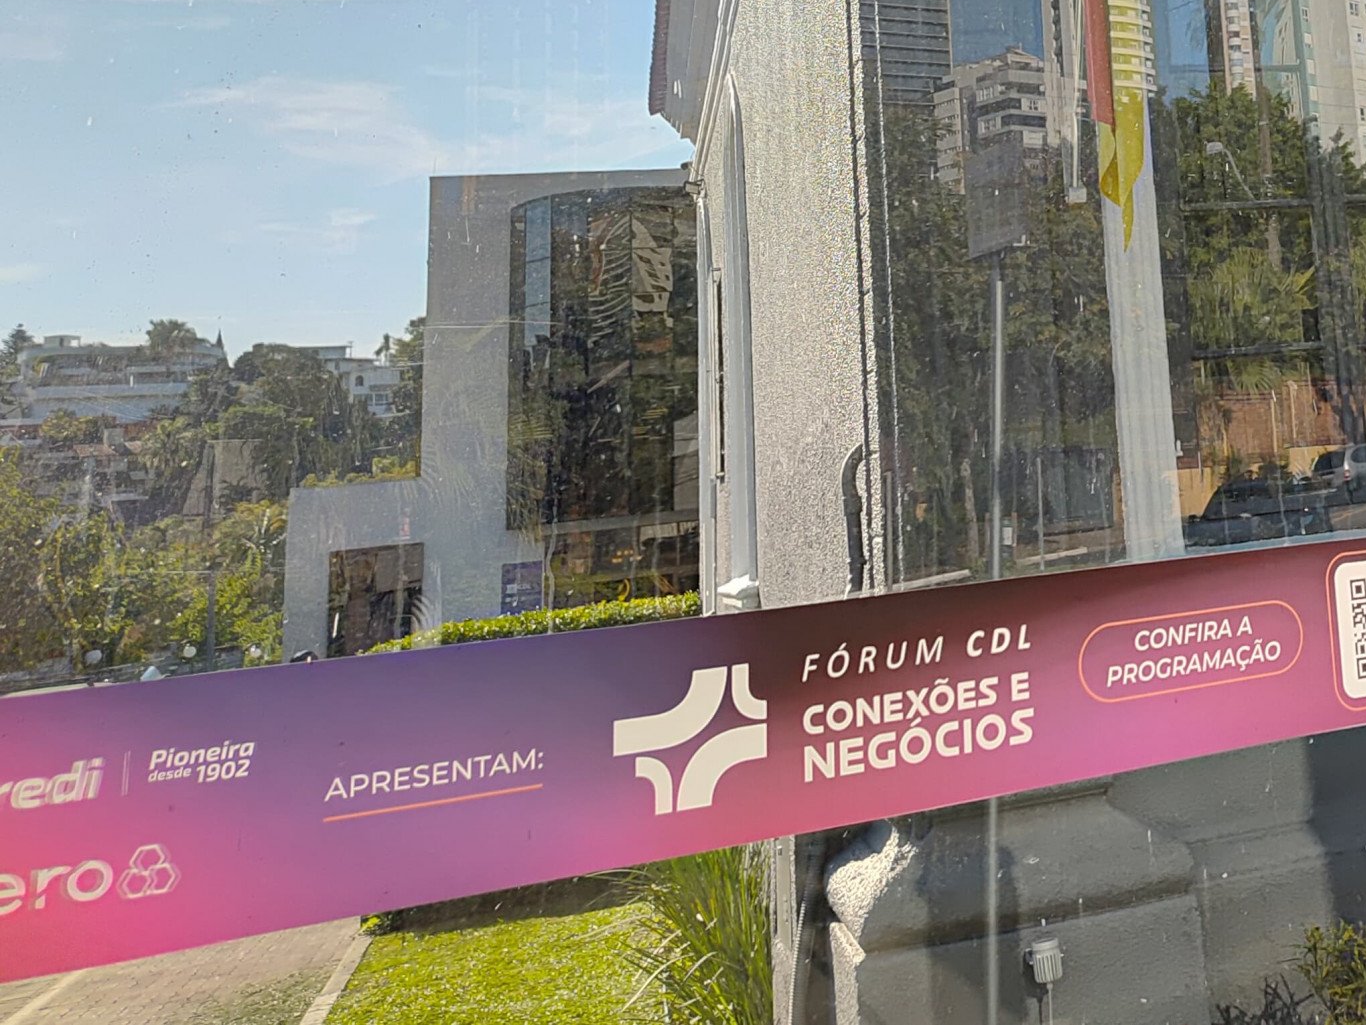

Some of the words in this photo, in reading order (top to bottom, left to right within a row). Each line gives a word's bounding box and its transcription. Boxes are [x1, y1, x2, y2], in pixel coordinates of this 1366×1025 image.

[801, 635, 944, 683] FÓRUM
[966, 624, 1031, 657] CDL
[1134, 618, 1233, 651] CONFIRA
[1236, 616, 1253, 636] A
[1106, 638, 1282, 687] PROGRAMAÇÃO
[802, 676, 999, 735] CONEXÕES
[1010, 671, 1031, 701] E
[147, 766, 192, 782] desde
[196, 759, 251, 783] 1902
[148, 740, 256, 770] Pioneira
[803, 707, 1035, 783] NEGÓCIOS
[324, 747, 545, 802] APRESENTAM:
